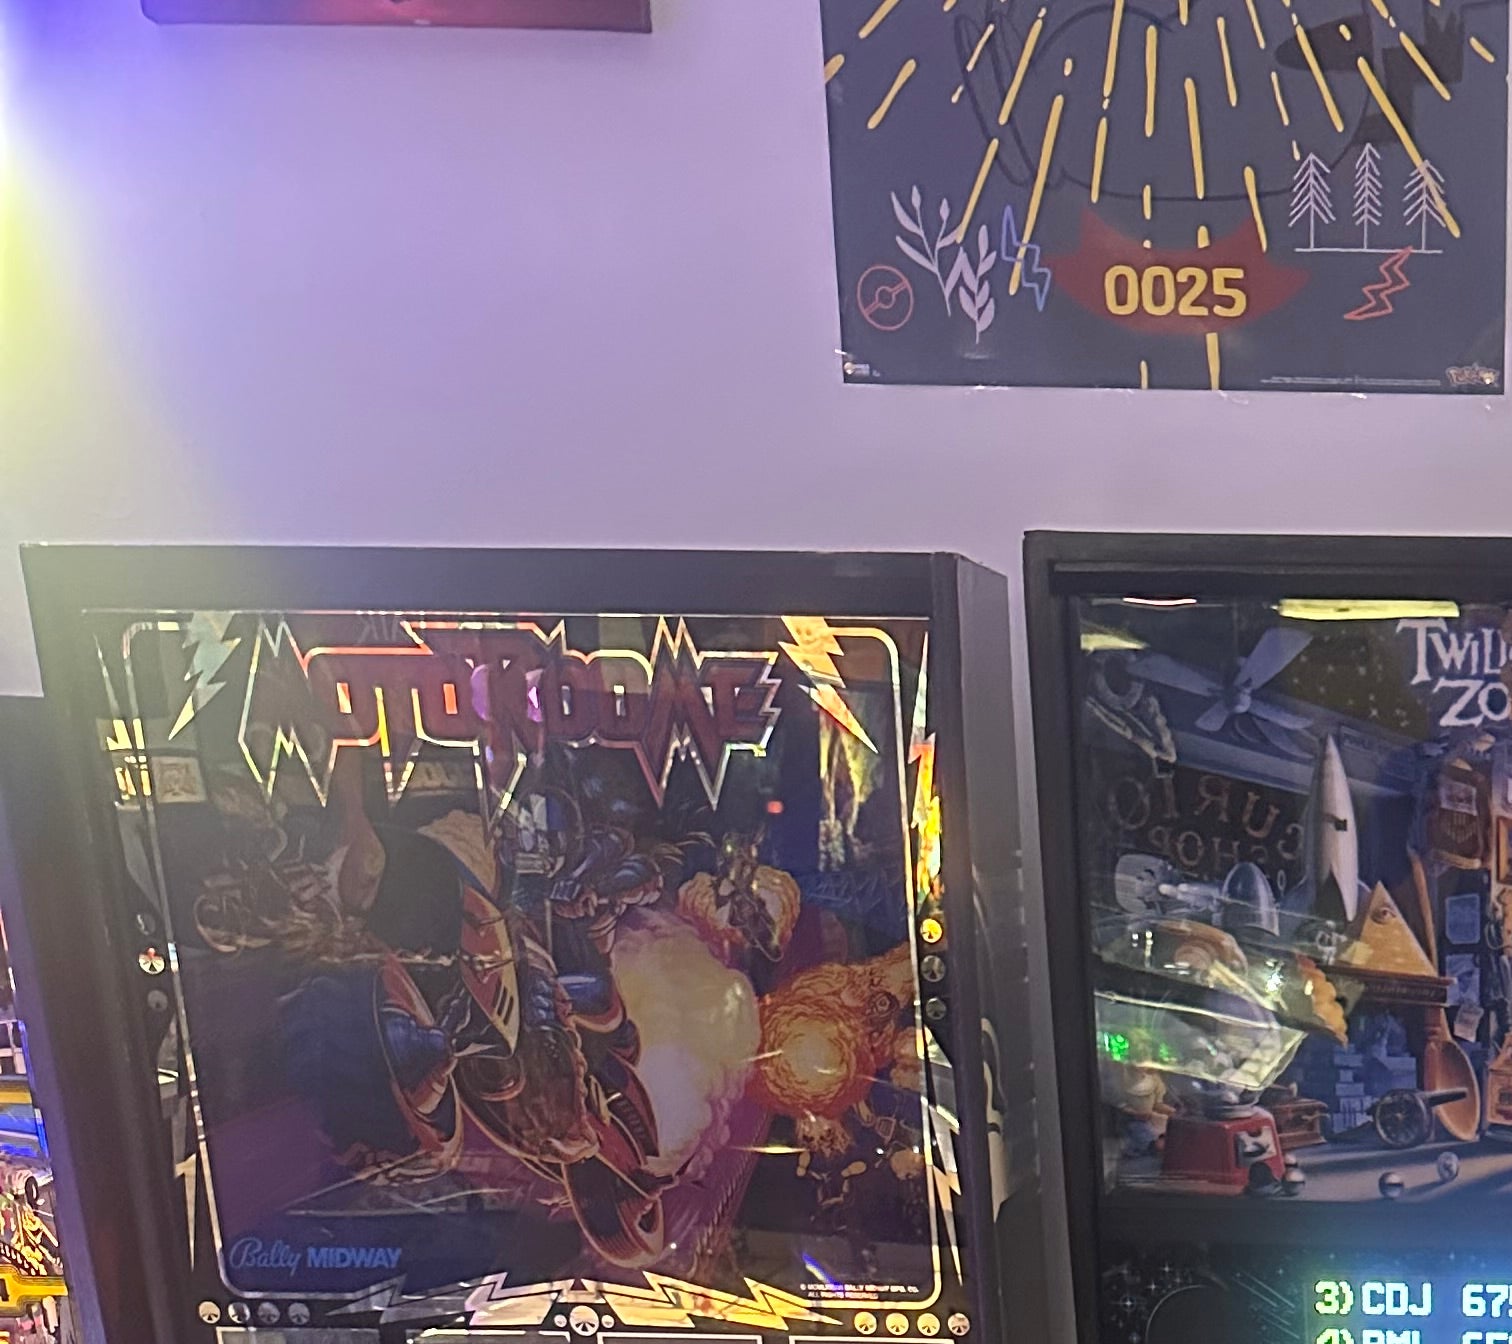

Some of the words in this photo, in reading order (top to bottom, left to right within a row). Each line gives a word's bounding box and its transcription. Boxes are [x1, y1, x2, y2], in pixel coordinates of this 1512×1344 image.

[1104, 265, 1248, 318] 0025
[229, 1236, 303, 1278] Bally
[307, 1246, 402, 1269] MIDWAY
[1313, 1279, 1356, 1317] 3)
[1361, 1281, 1435, 1317] CDJ
